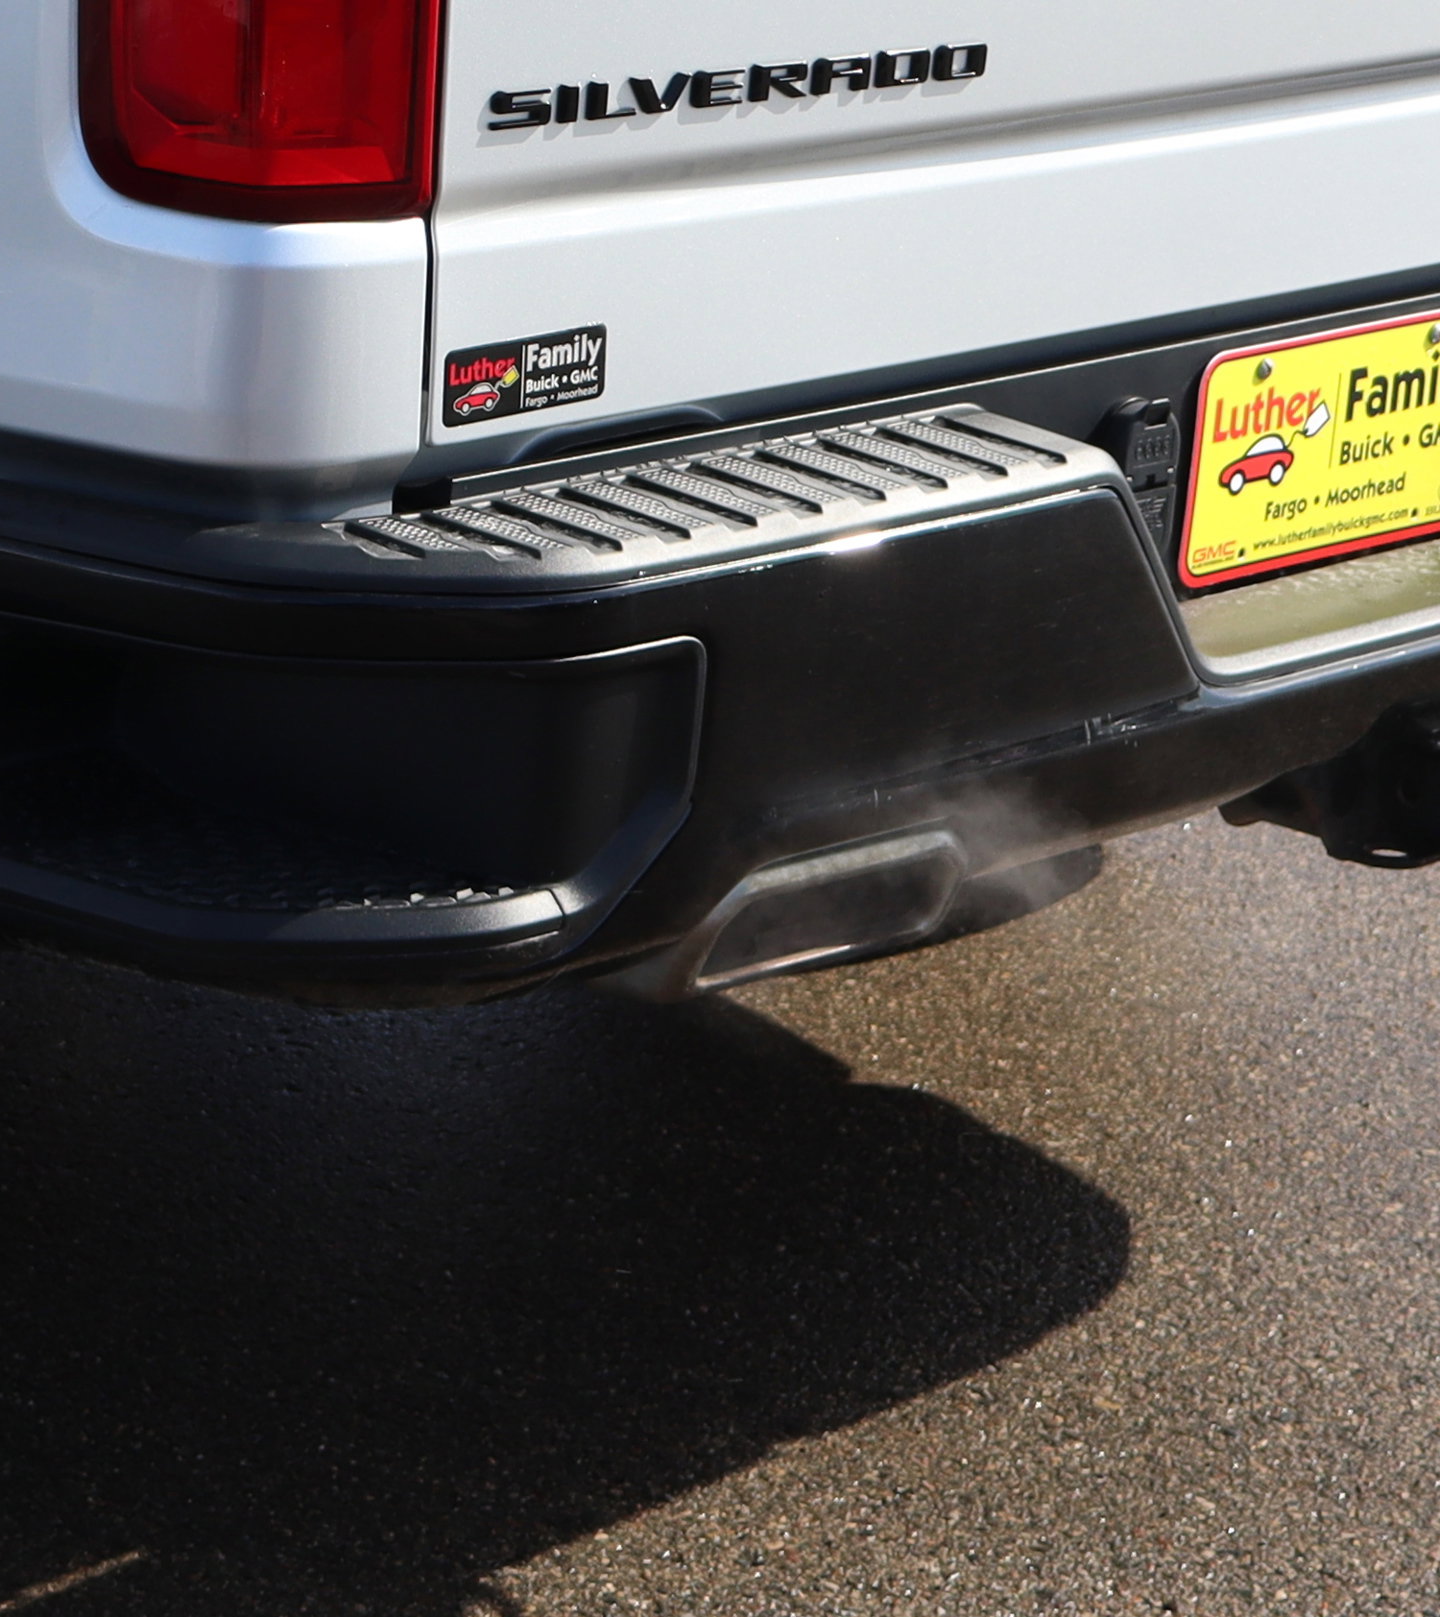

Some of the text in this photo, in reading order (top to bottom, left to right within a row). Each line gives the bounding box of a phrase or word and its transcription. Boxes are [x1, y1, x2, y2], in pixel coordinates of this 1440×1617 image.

[488, 42, 988, 131] SILVERADO
[449, 333, 602, 386] Luther Family
[525, 366, 598, 394] Buick GMC
[525, 384, 598, 408] Fargo Moorhead
[1212, 386, 1321, 443] Luther
[1339, 431, 1395, 466] Buick
[1264, 471, 1406, 521] Fargo Moorhead
[1193, 539, 1237, 563] GMC
